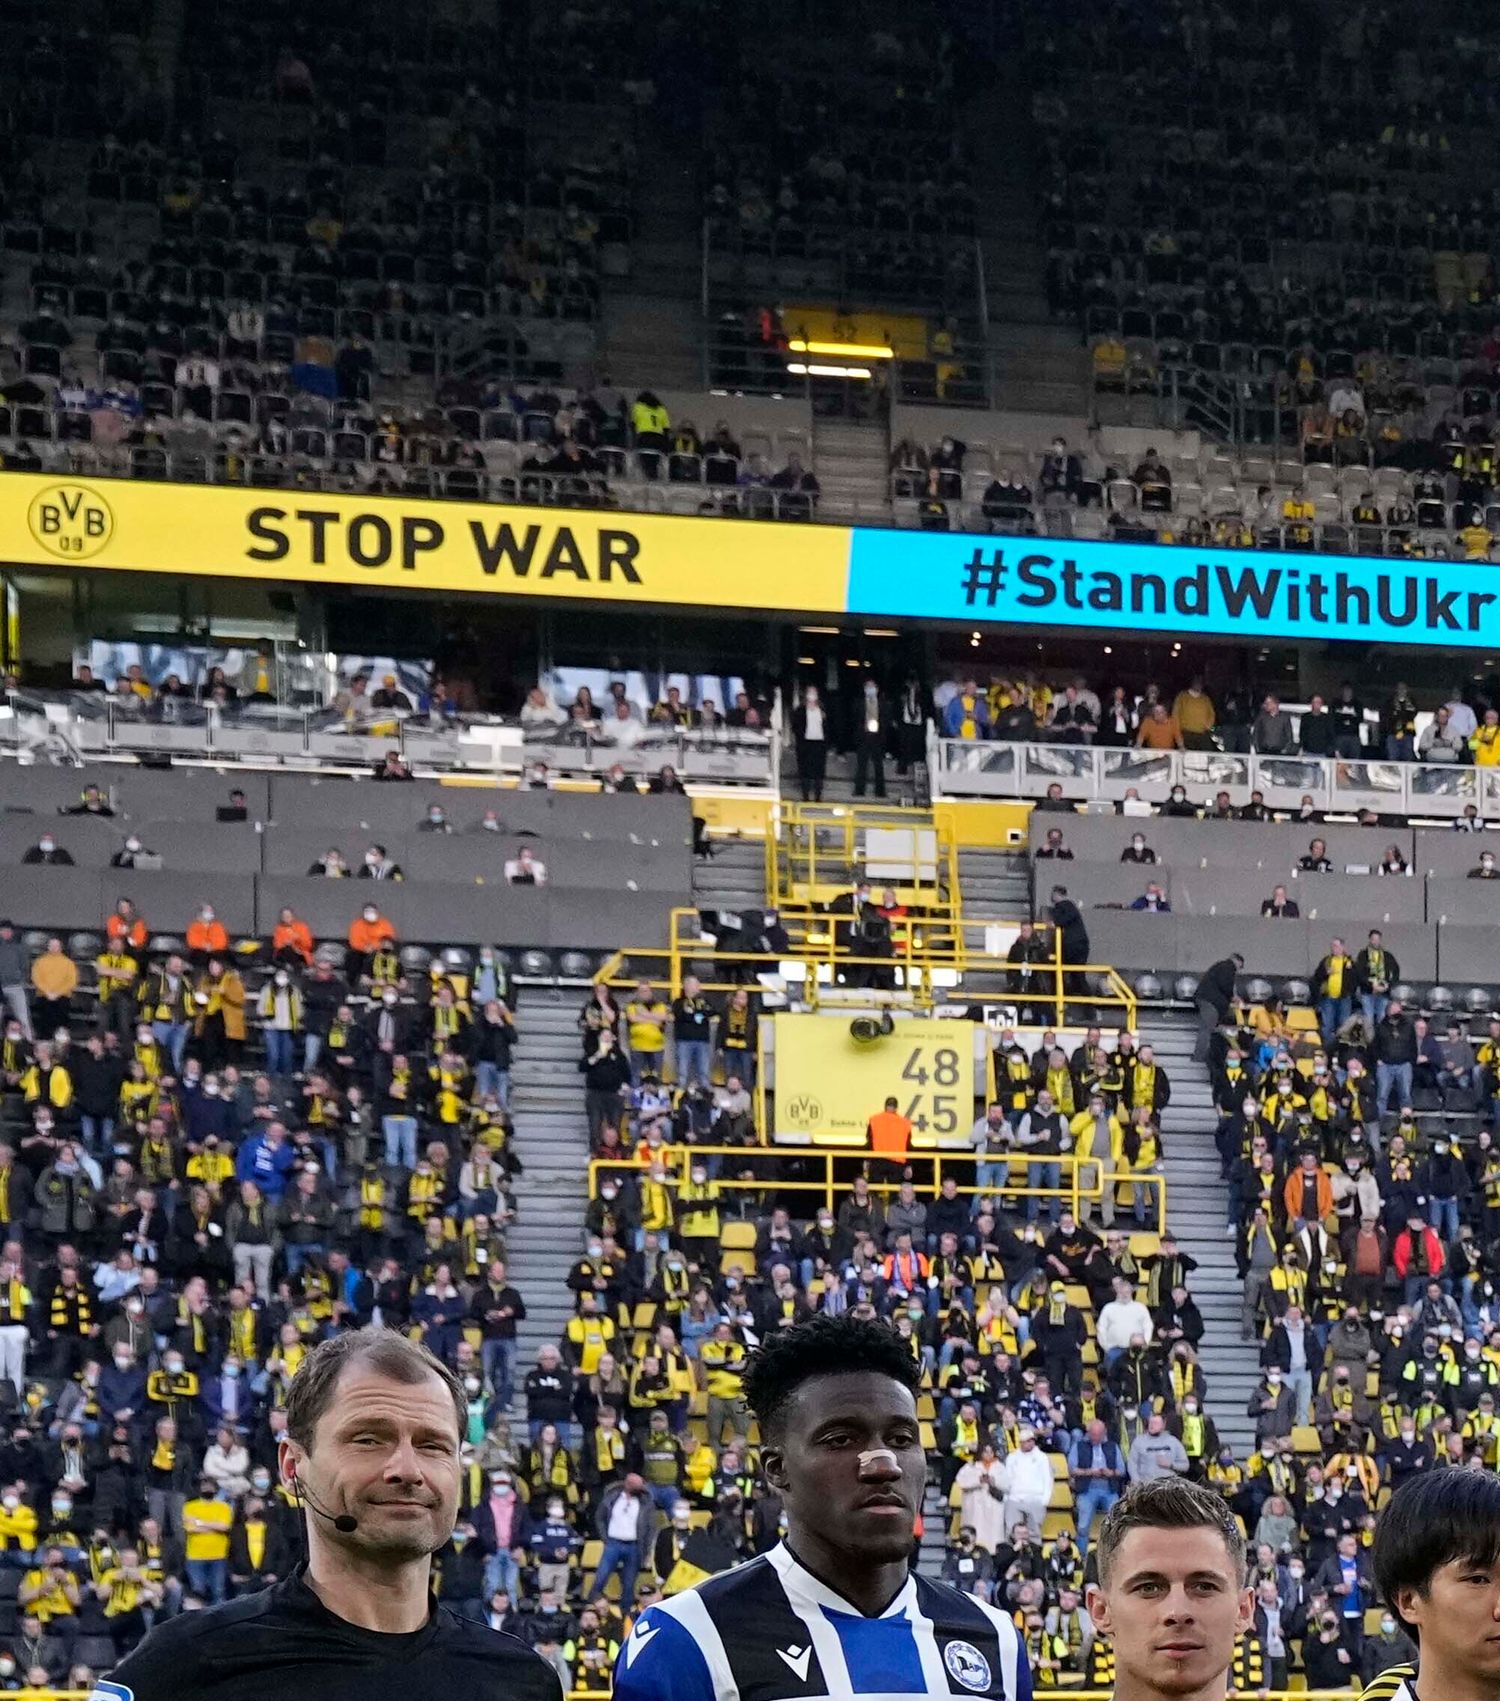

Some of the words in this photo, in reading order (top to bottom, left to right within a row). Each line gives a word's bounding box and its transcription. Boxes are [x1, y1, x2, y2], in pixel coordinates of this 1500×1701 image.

[39, 491, 106, 536] BVB
[245, 506, 445, 570] STOP
[468, 520, 643, 585] WAR
[902, 1047, 959, 1086] 48
[903, 1095, 957, 1133] 45
